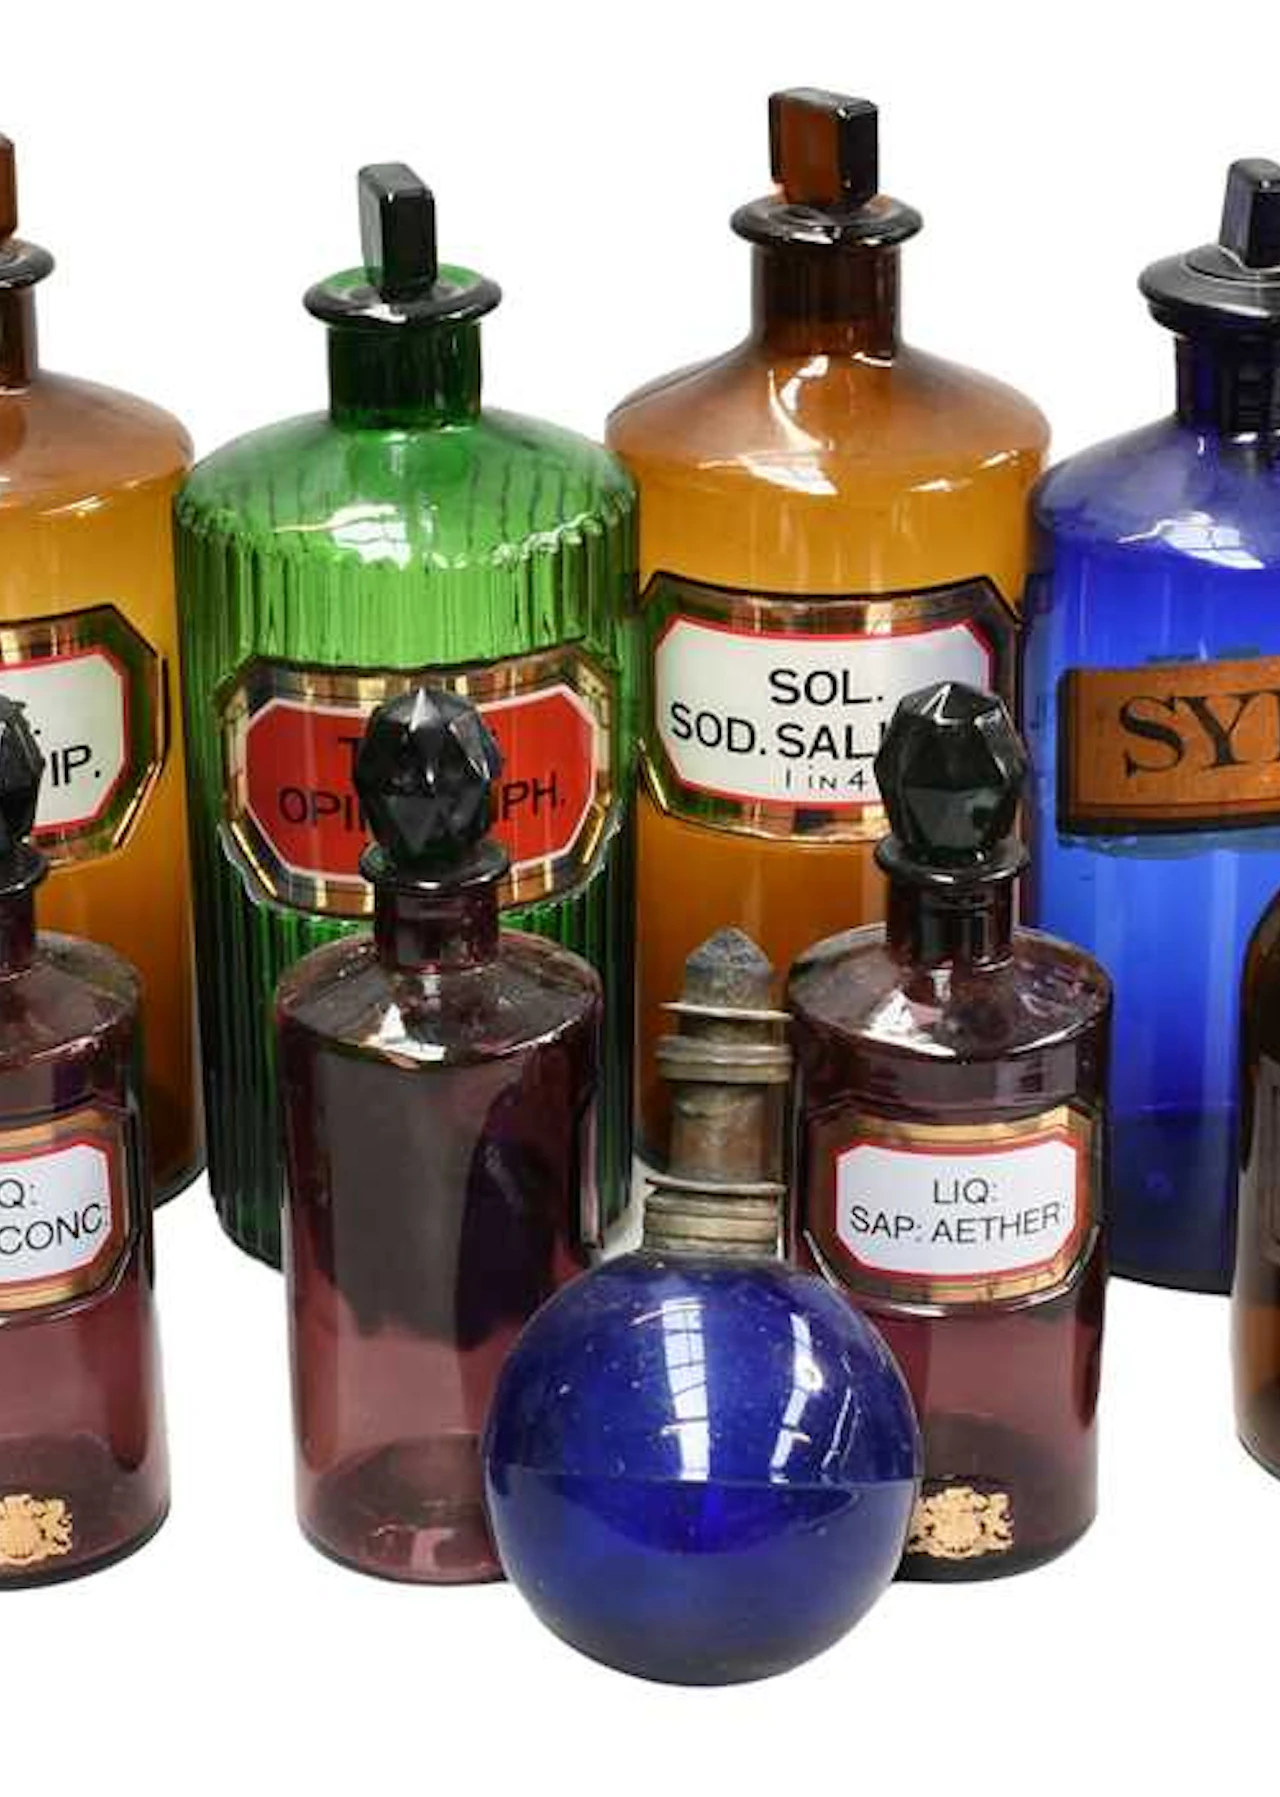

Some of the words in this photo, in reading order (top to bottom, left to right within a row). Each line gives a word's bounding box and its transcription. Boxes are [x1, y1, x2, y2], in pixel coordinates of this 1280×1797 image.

[768, 666, 884, 706] SOL.
[670, 700, 767, 756] SOD.
[846, 768, 869, 791] 4
[932, 1176, 998, 1206] LIQ:
